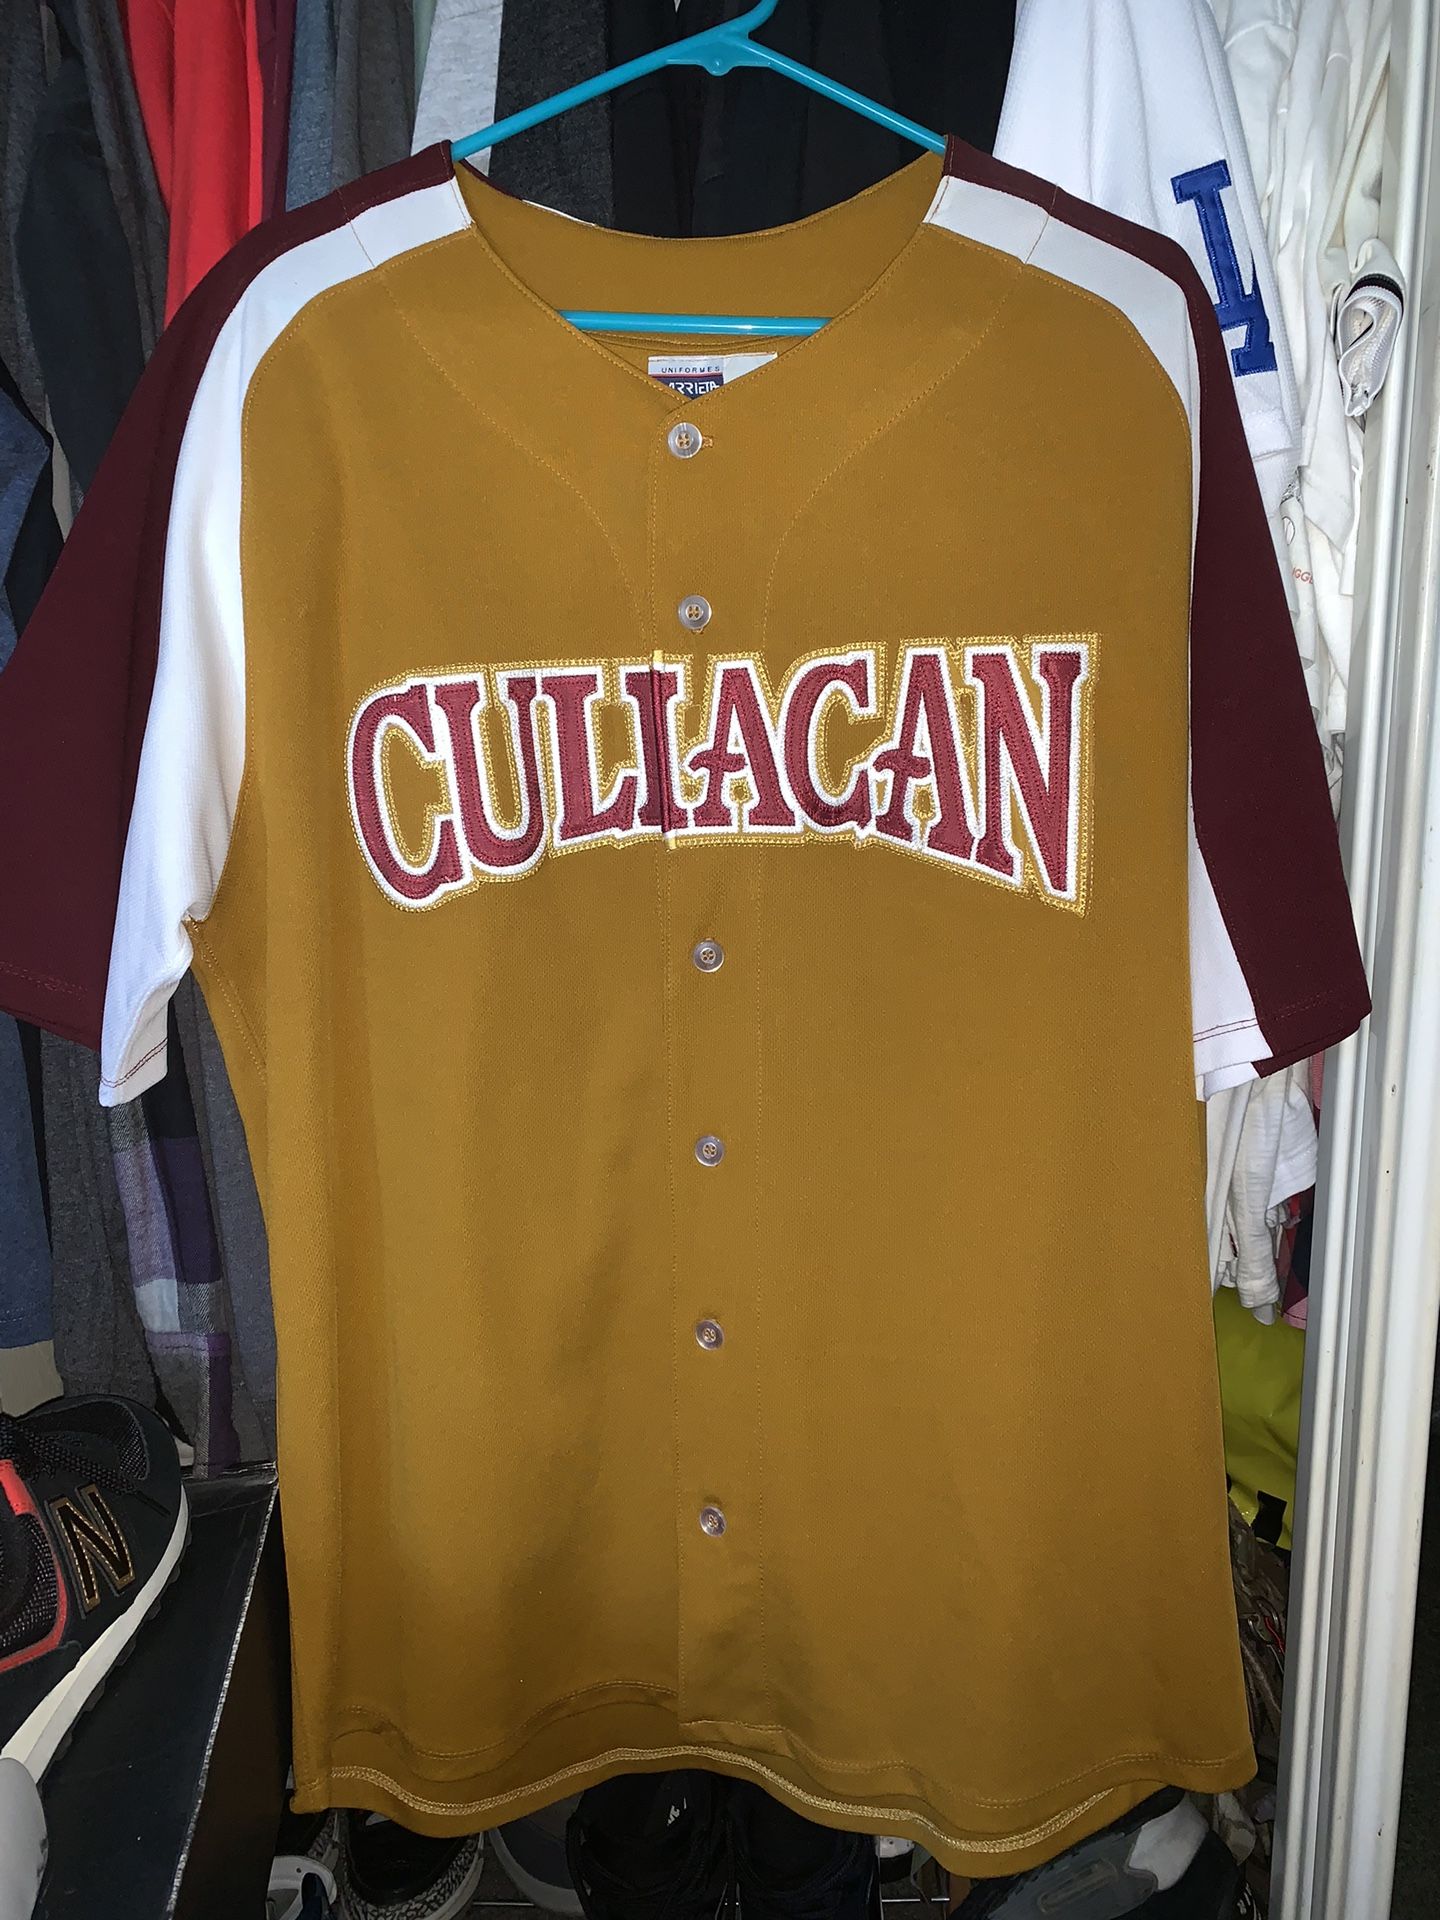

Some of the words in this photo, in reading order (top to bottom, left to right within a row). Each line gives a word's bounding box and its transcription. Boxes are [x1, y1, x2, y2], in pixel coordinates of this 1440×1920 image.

[661, 366, 720, 374] UNIFORMES
[346, 637, 1094, 912] CULIACAN
[49, 1483, 136, 1614] N
